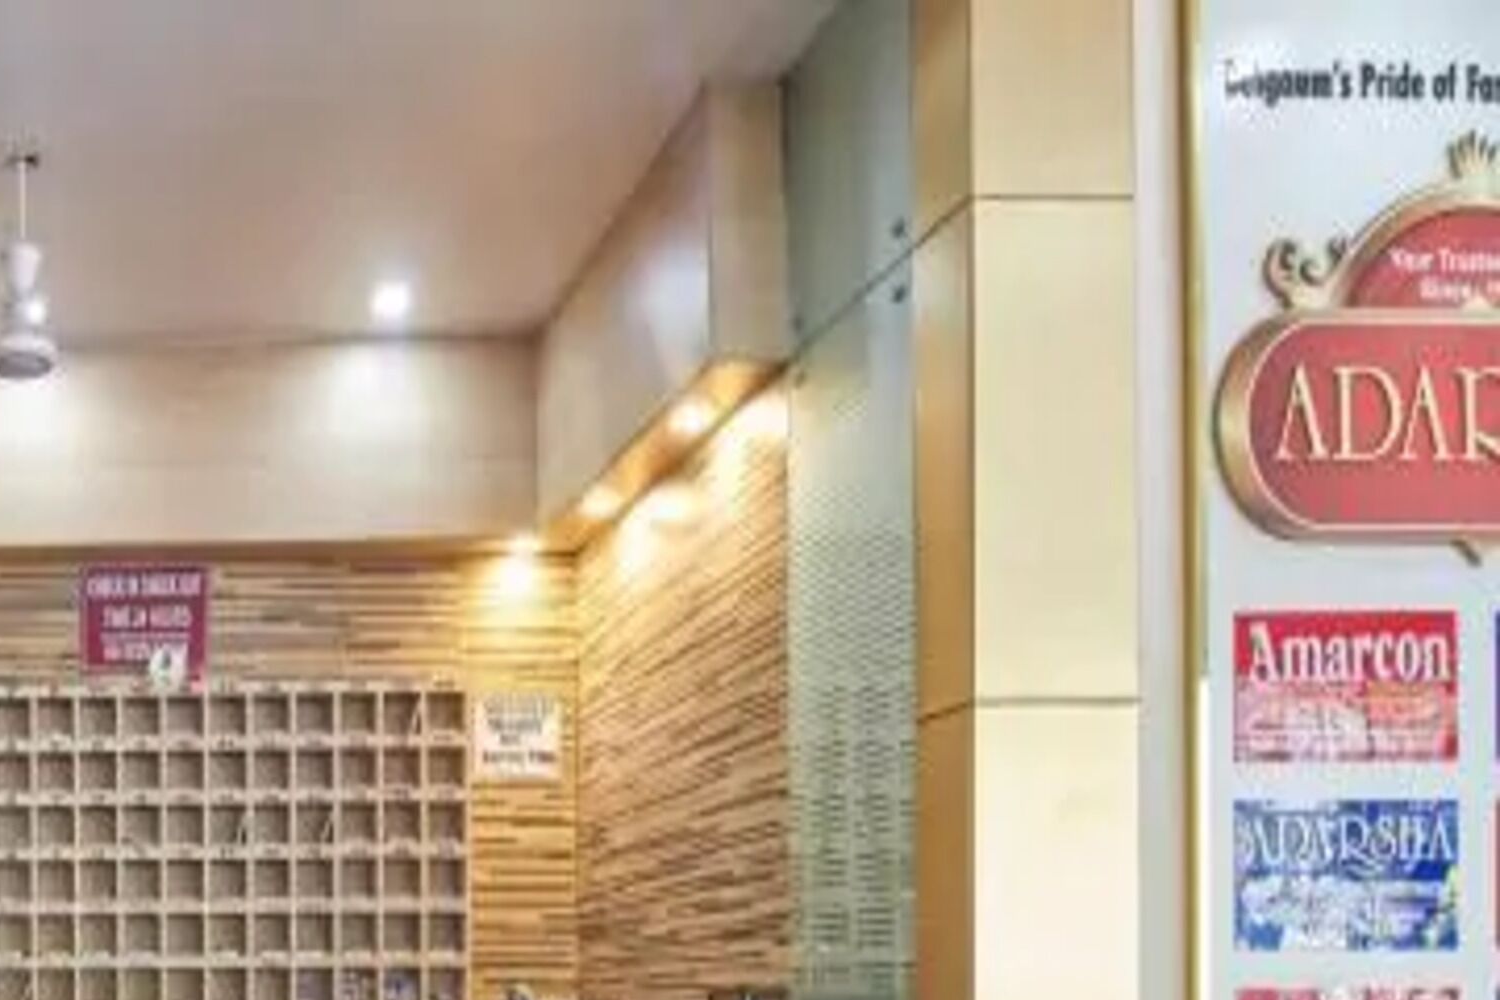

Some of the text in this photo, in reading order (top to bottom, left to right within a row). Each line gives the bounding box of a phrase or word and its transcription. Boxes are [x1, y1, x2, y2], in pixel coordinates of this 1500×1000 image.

[1360, 62, 1425, 99] Pride
[1432, 63, 1456, 103] of
[1250, 620, 1450, 683] Amarcon
